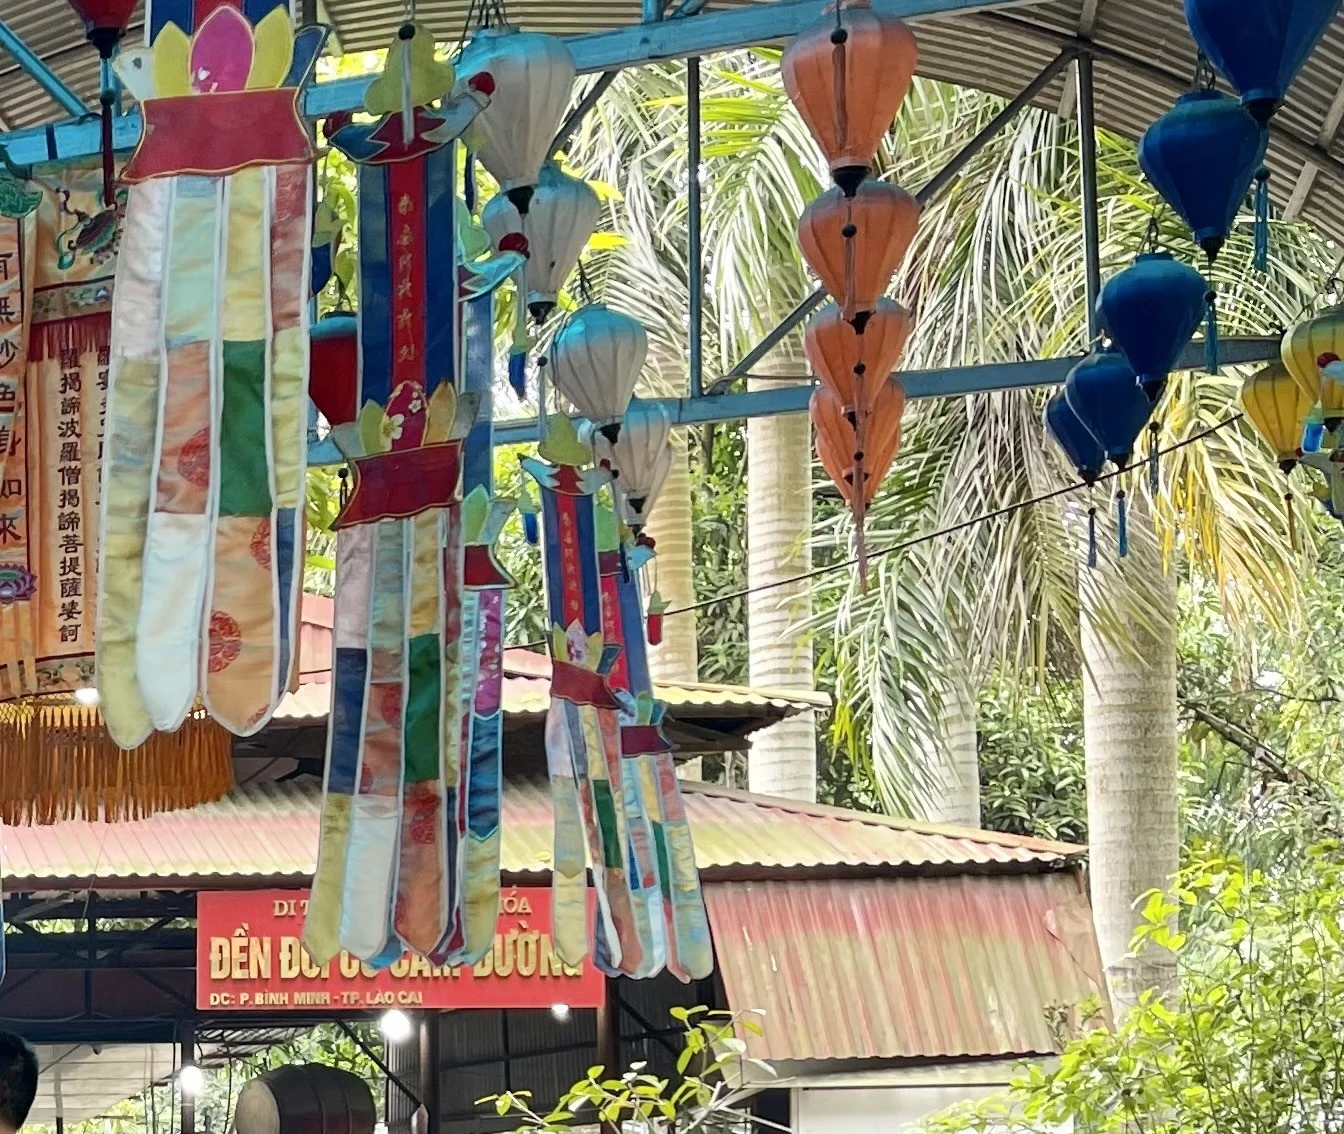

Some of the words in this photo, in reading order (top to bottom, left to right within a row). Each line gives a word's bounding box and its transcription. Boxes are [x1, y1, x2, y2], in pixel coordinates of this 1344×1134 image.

[273, 900, 296, 916] DI
[209, 923, 272, 980] ĐỀN
[473, 919, 584, 978] ƯỜN
[293, 992, 330, 1005] MINH
[365, 989, 395, 1004] LÀO
[397, 992, 423, 1004] CAI
